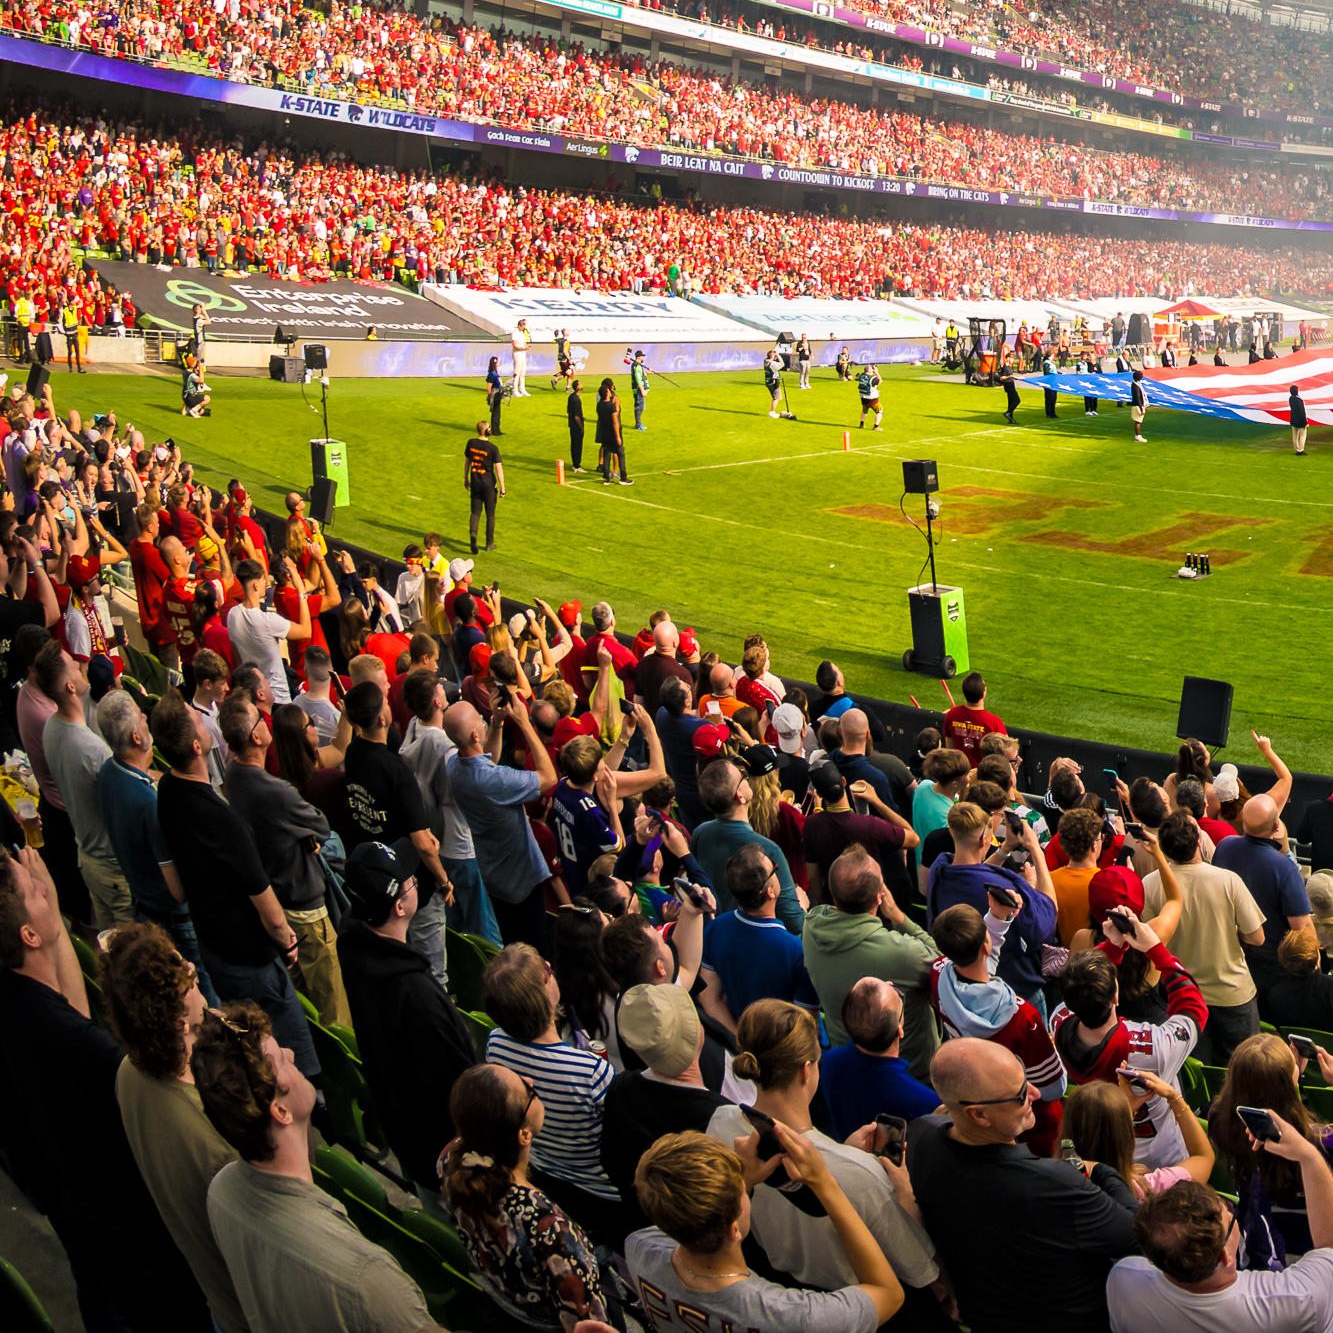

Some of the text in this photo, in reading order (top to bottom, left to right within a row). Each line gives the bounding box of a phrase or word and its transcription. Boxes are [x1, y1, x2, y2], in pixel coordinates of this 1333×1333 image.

[866, 18, 897, 35] K-STATE
[971, 45, 997, 59] K-STATE
[1060, 68, 1083, 80] K-STATE
[281, 94, 437, 132] K-STATE WILDCATS
[1201, 102, 1222, 112] K-STATE
[1287, 115, 1314, 124] K-STATE
[660, 154, 745, 175] BEIR LEAT NA CAIT
[778, 169, 900, 192] COUNTDOWN TO KICKOFF 13:20
[928, 186, 990, 202] BRING ON THE CATS
[1092, 204, 1114, 213] K-STATE
[1228, 216, 1245, 225] K-STATE
[230, 284, 404, 306] Enterprise
[251, 299, 371, 317] Ireland
[489, 296, 673, 313] KERRY
[207, 316, 451, 332] onnect with Irish Innovation
[952, 721, 966, 729] IOWA
[967, 723, 985, 733] STATE
[555, 817, 577, 862] 18
